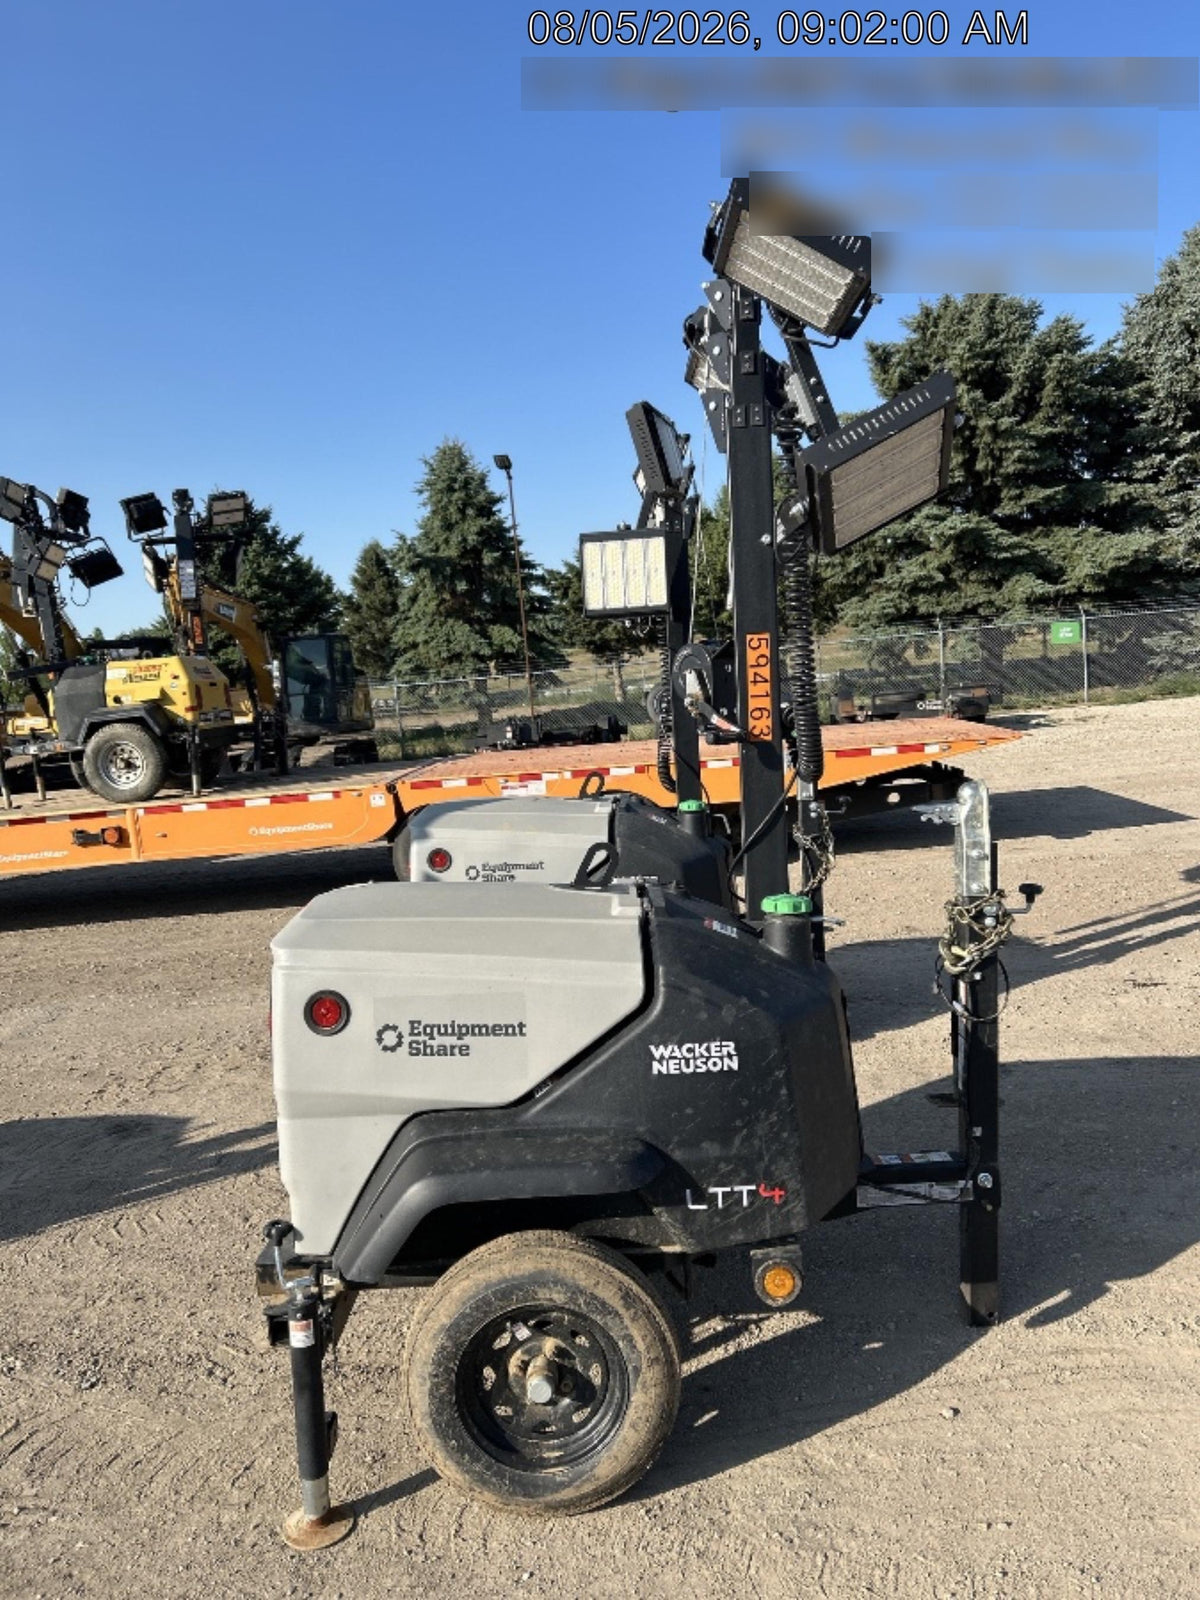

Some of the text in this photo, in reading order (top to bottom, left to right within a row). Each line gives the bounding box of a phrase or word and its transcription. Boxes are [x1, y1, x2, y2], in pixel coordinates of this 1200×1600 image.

[748, 637, 771, 738] 594163
[408, 1020, 527, 1040] Equipment
[408, 1040, 470, 1057] Share
[649, 1041, 737, 1060] WACKER
[652, 1056, 739, 1075] NEUSON
[685, 1183, 786, 1210] LTT4
